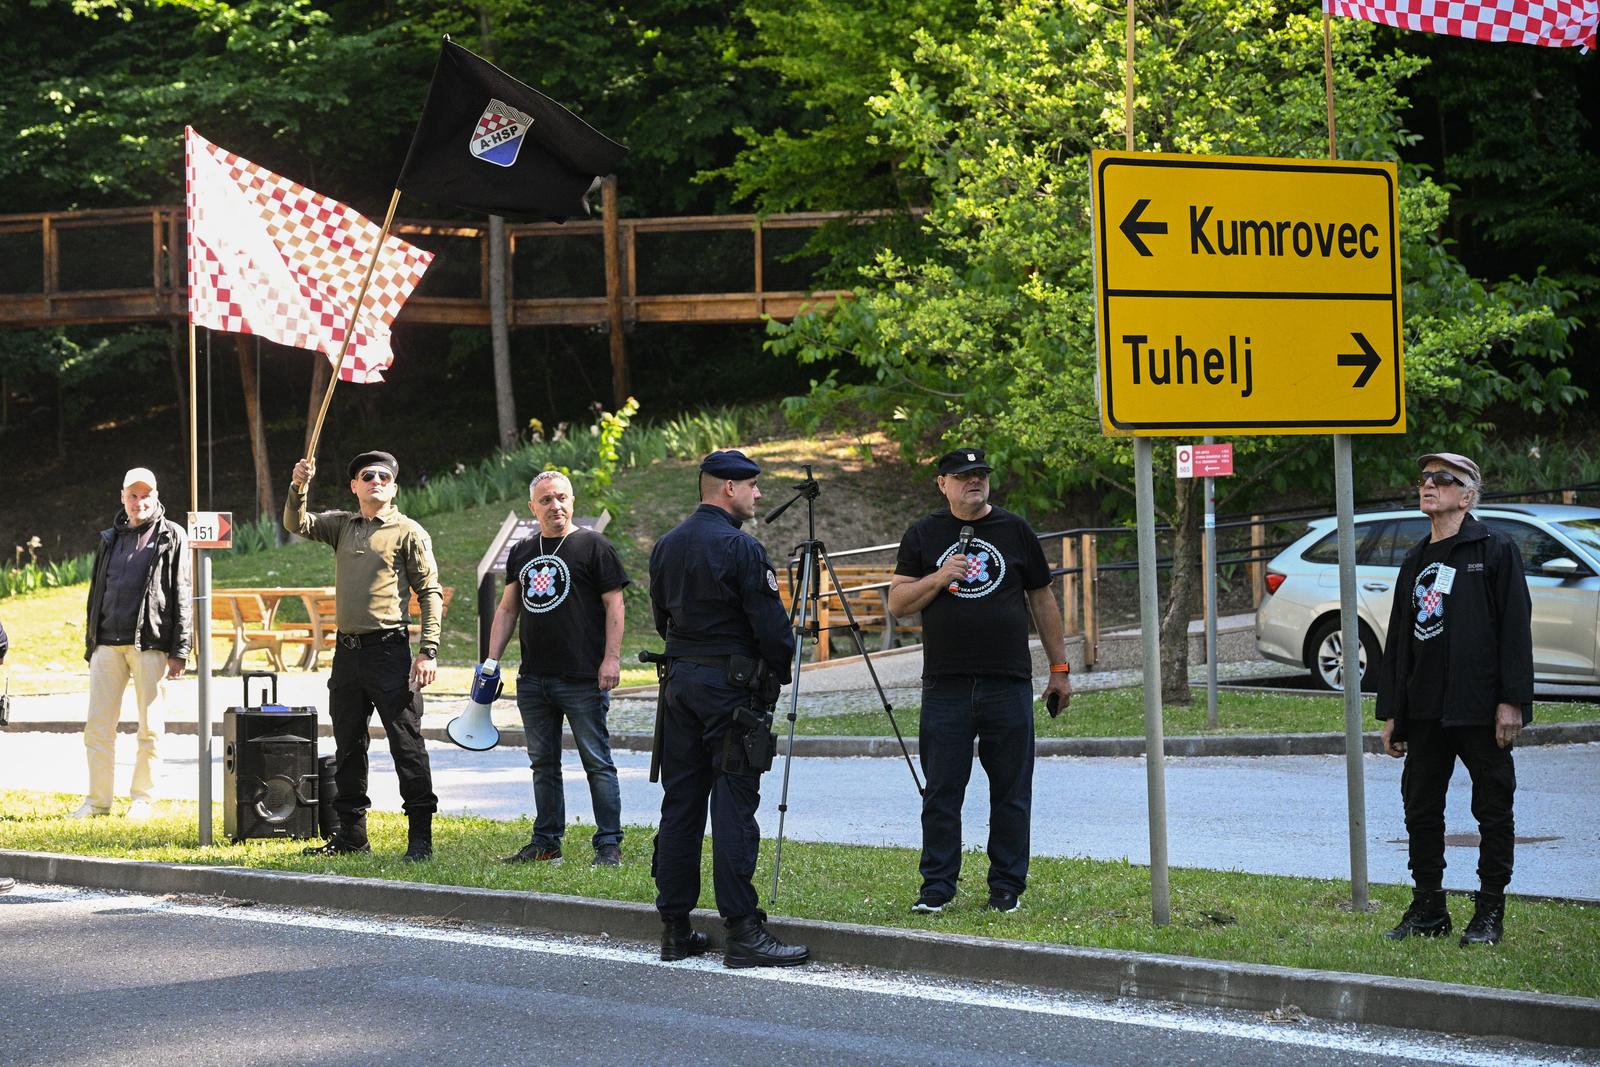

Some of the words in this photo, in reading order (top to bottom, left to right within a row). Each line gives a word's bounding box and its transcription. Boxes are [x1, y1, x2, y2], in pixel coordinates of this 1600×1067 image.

[480, 125, 518, 149] A-HSP
[1189, 205, 1380, 259] Kumrovec
[1122, 335, 1253, 398] Tuhelj
[193, 526, 213, 540] 151
